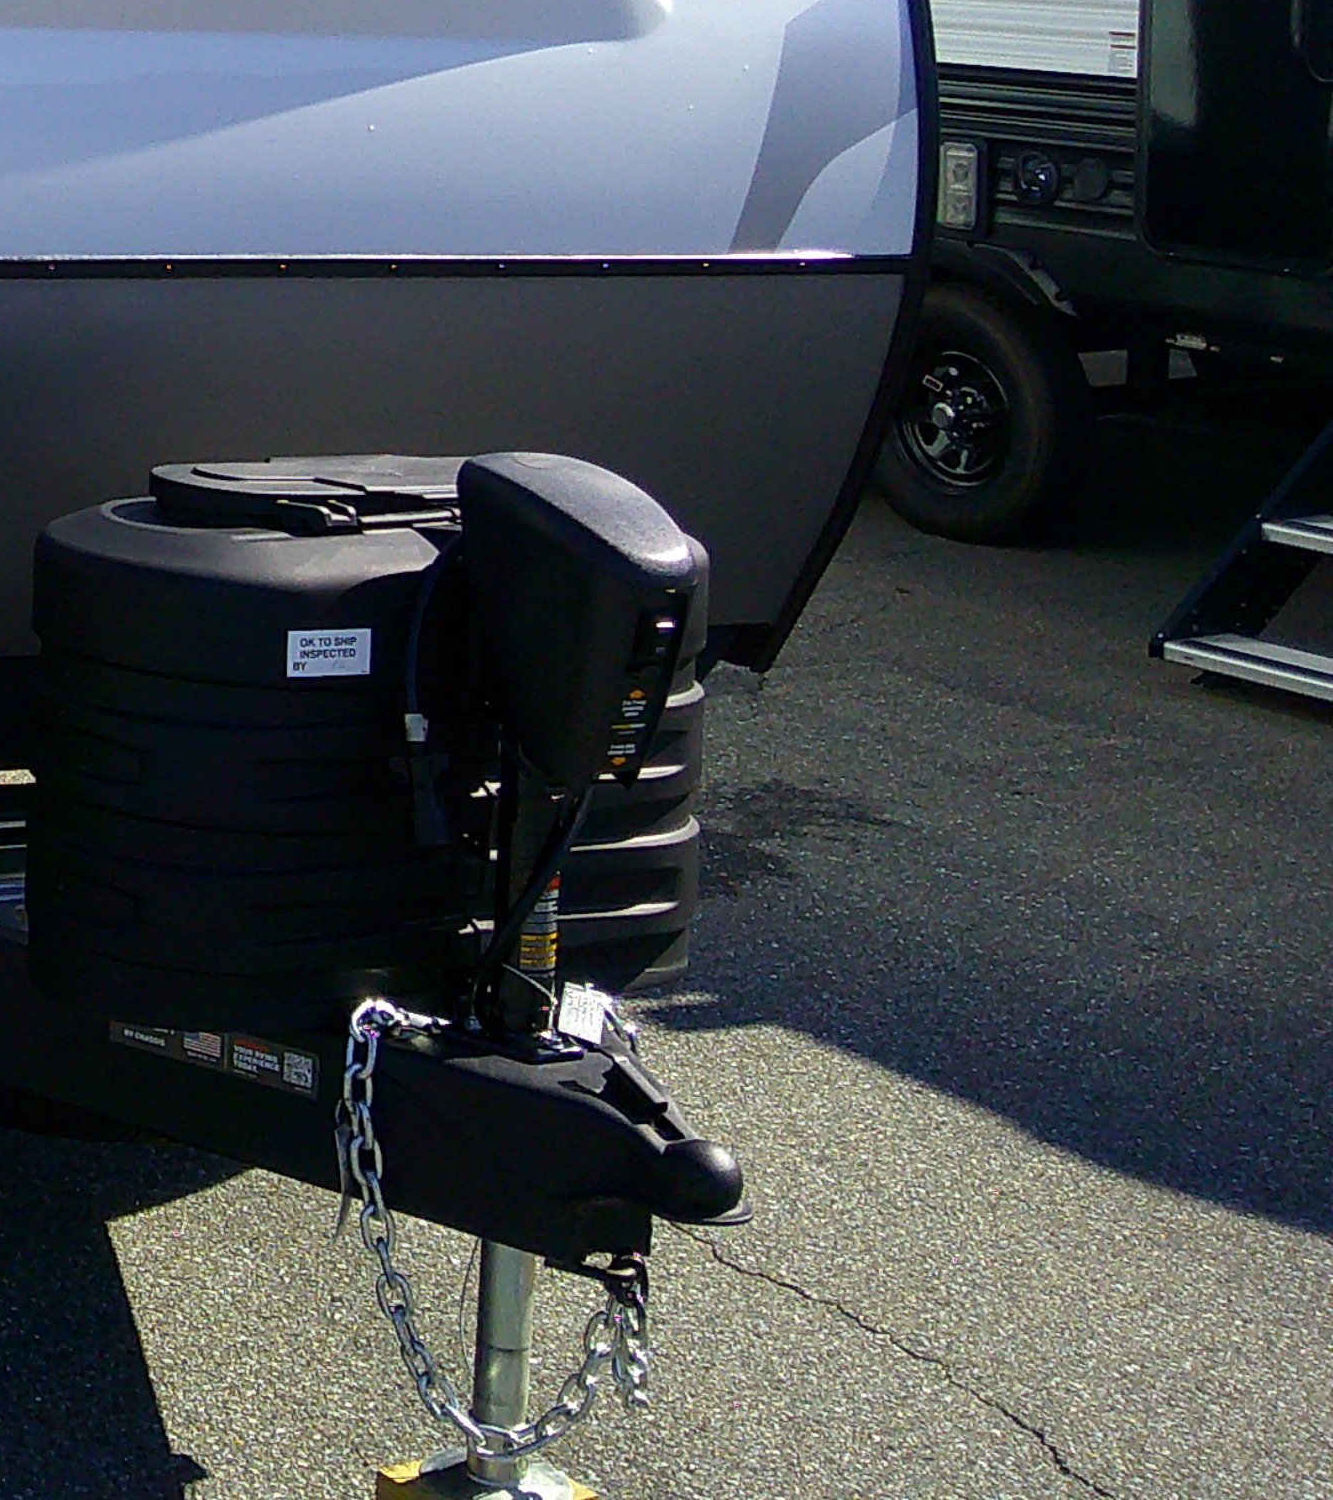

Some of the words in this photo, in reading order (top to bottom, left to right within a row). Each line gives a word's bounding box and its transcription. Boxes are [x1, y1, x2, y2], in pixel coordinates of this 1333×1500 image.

[300, 638, 316, 648] OK
[319, 637, 332, 647] TO
[334, 637, 357, 647] SHIP
[300, 648, 356, 659] INSPECTED
[293, 661, 307, 671] BY
